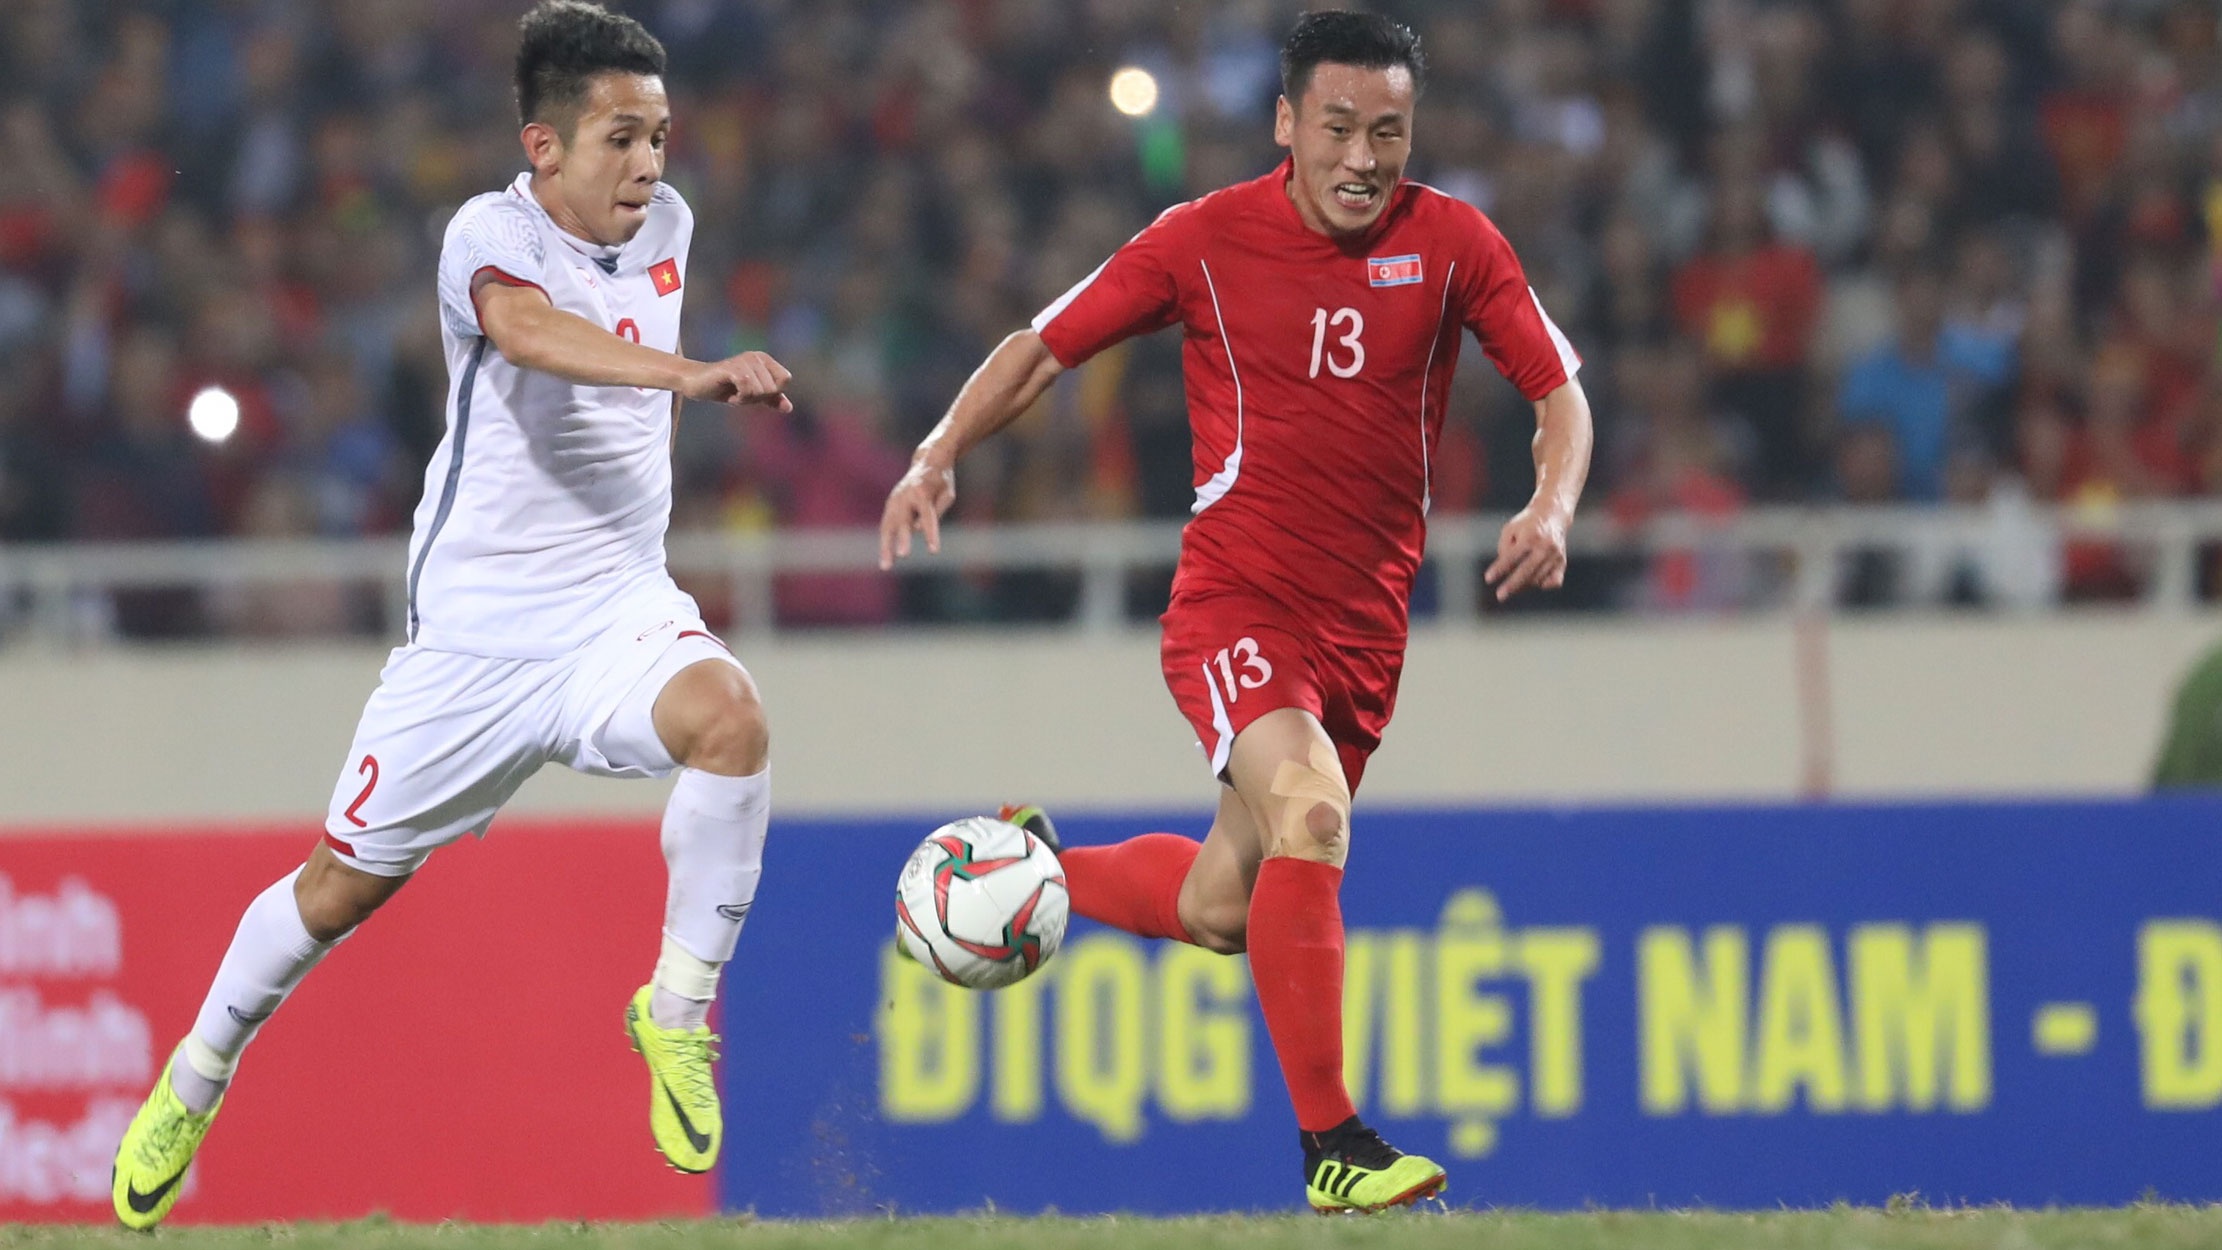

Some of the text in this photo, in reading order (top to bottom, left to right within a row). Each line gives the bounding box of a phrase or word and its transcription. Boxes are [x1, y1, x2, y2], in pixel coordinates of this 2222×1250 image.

[1308, 307, 1366, 379] 13
[1213, 637, 1273, 704] 13
[344, 754, 379, 828] 2
[1638, 923, 1992, 1113] NAM
